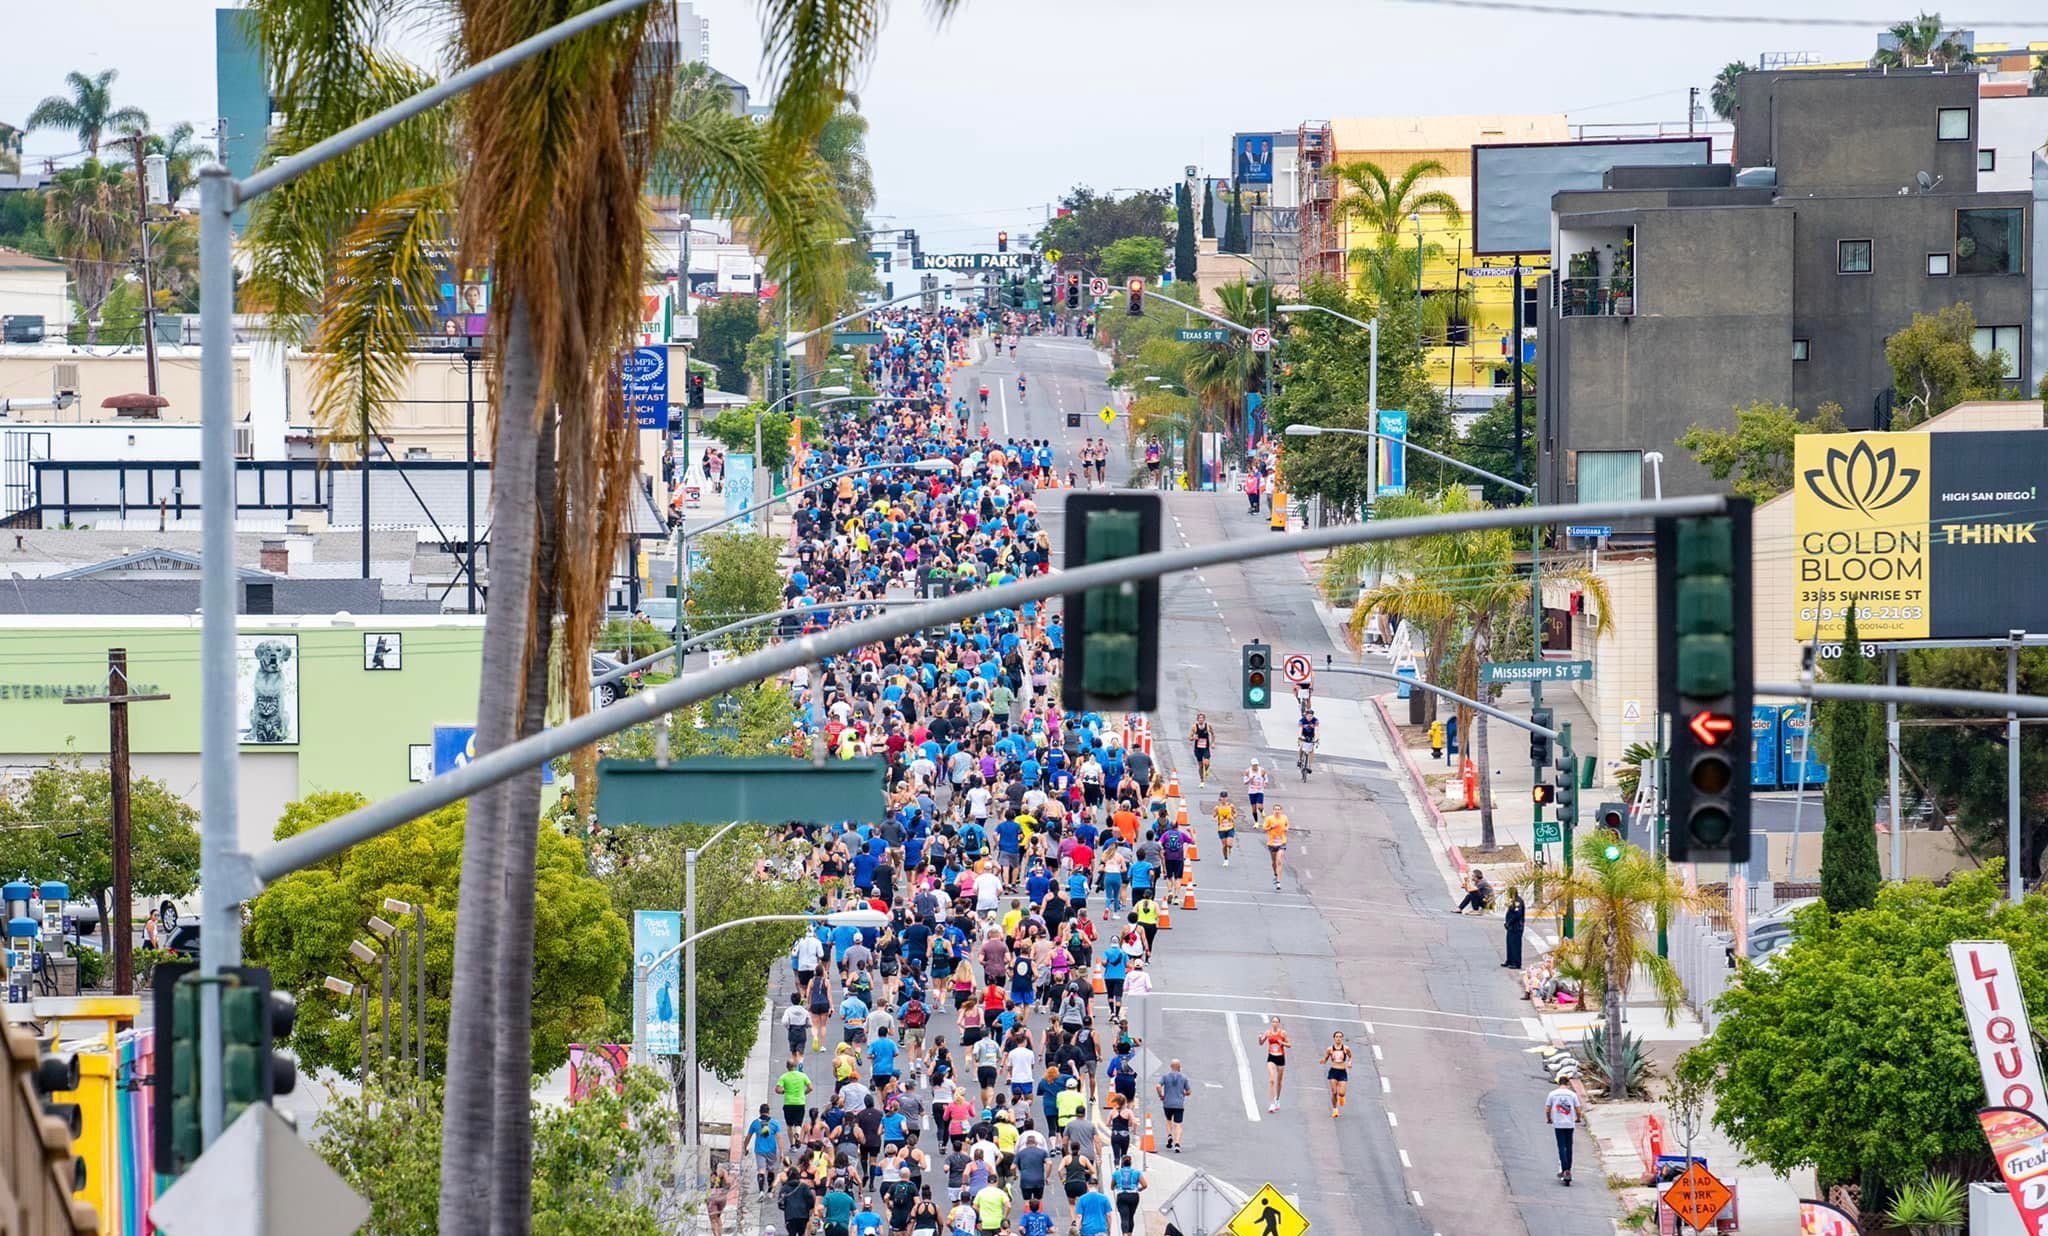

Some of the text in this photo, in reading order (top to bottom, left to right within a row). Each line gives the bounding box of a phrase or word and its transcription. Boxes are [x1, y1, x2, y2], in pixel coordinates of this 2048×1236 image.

[924, 255, 1019, 268] NORTH PARK
[1942, 486, 2036, 501] HIGH SAN DIEGO!
[1941, 523, 2037, 545] THINK
[1802, 530, 1921, 555] GOLDN
[1801, 557, 1922, 581] BLOOM
[1840, 590, 1901, 601] SUNRISE
[1905, 590, 1922, 601] ST
[1492, 666, 1552, 679] MISSISSIPPI
[1555, 665, 1568, 677] ST
